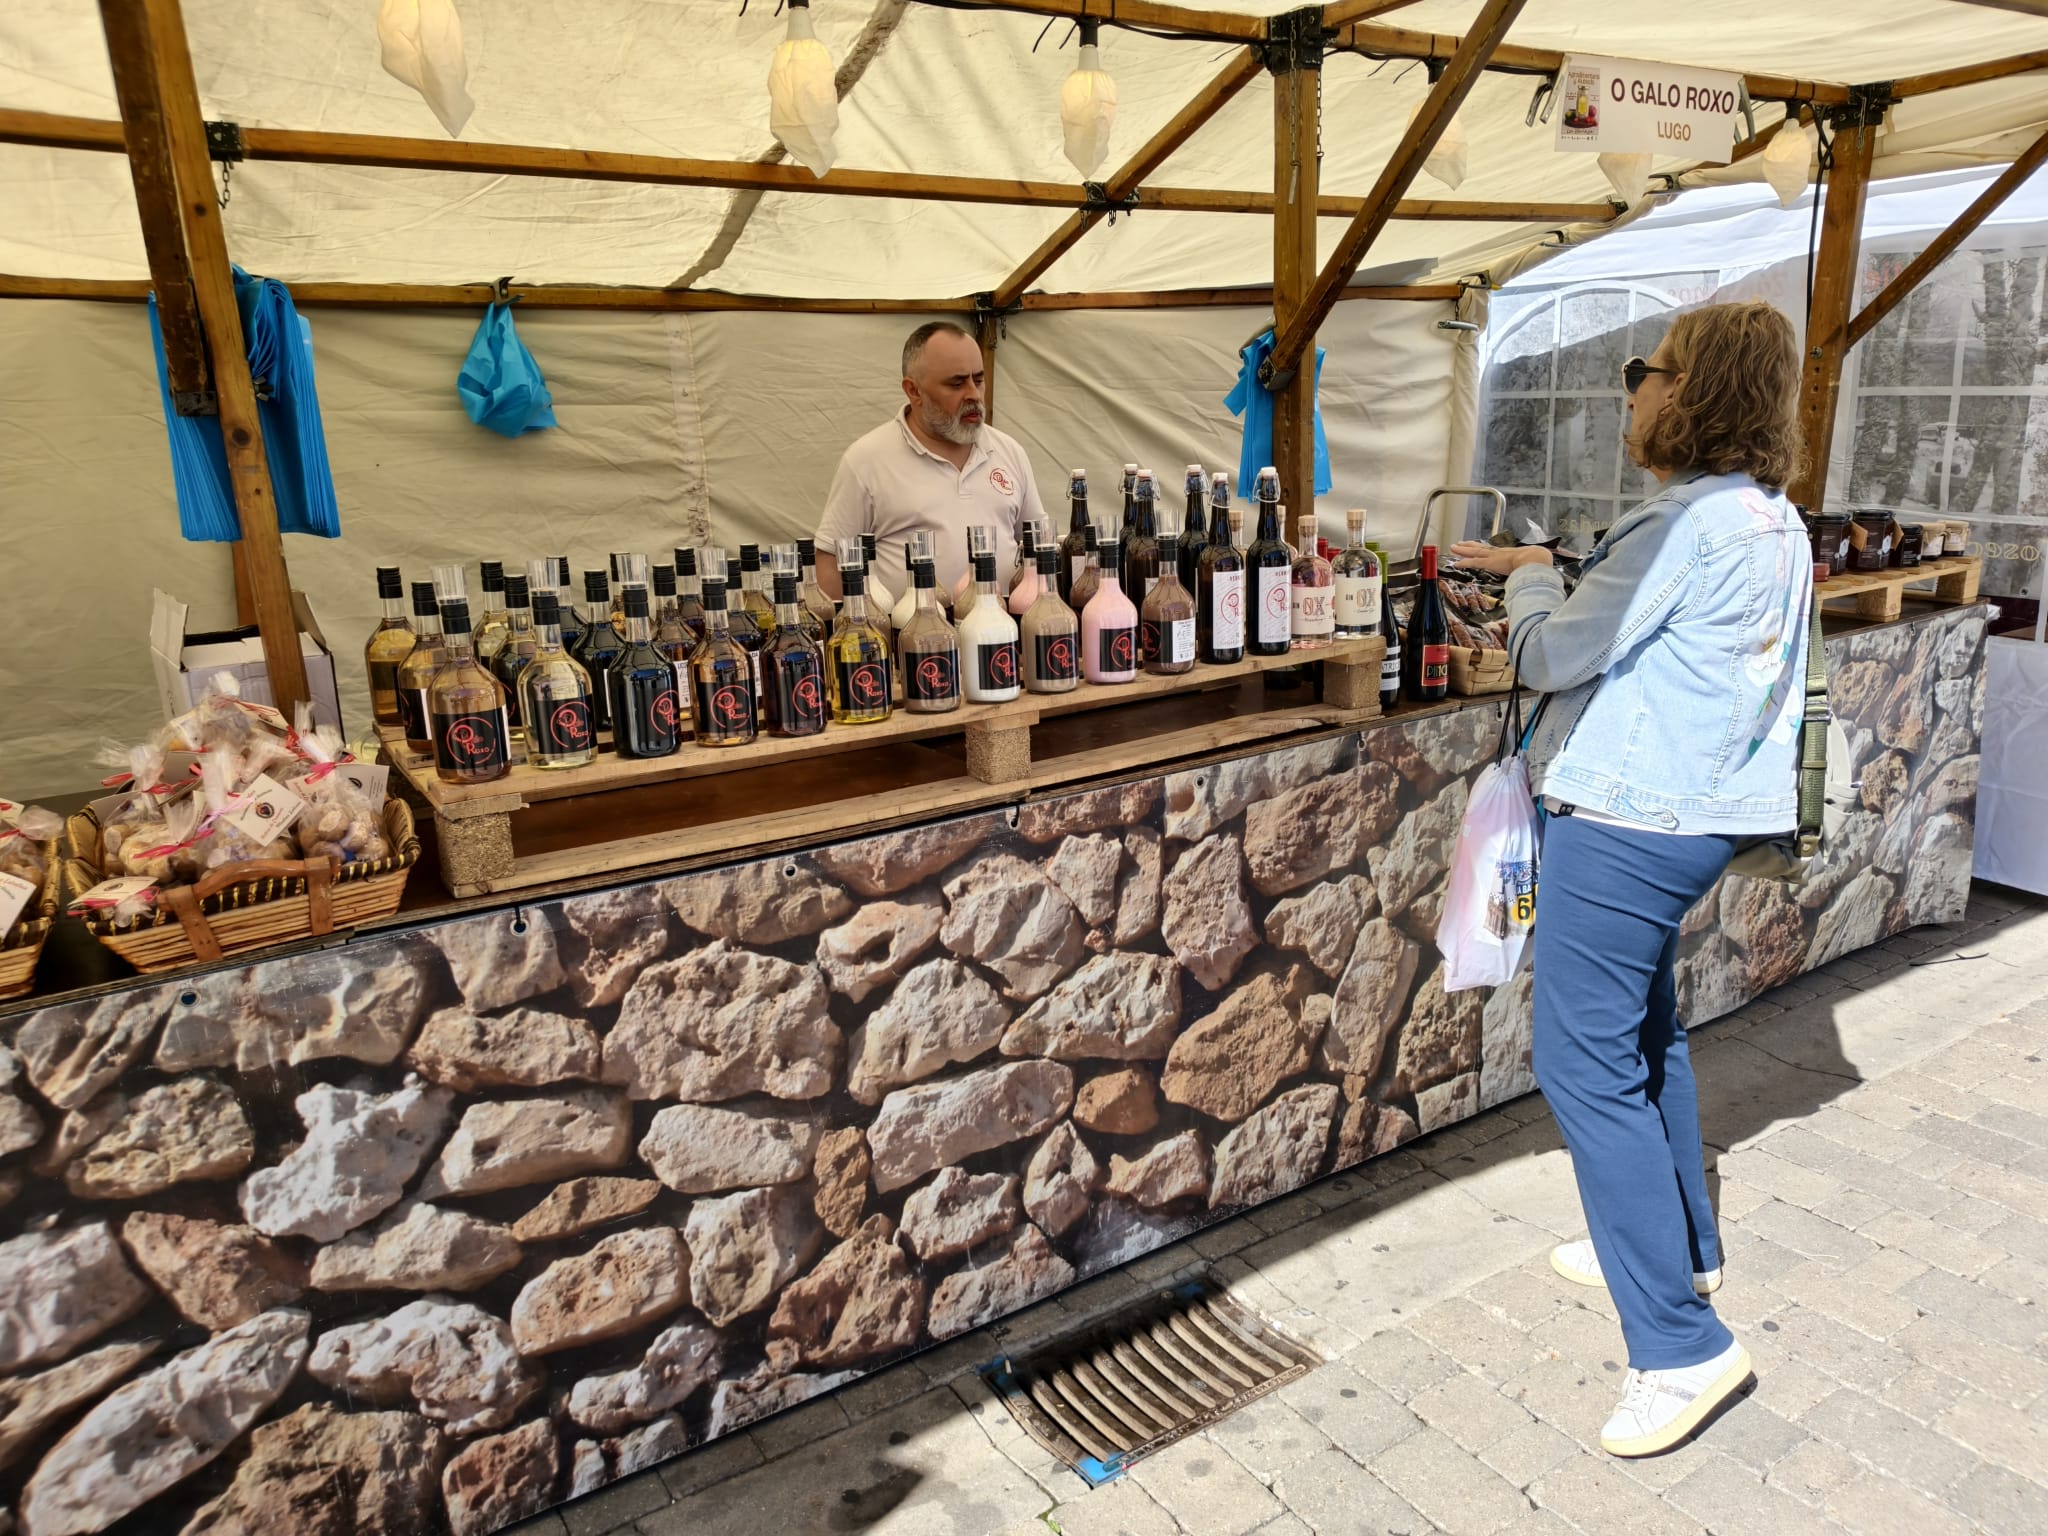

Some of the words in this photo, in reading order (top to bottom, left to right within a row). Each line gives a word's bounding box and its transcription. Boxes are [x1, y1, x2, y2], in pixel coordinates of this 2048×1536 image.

[1610, 78, 1626, 103] O
[1630, 80, 1681, 108] GALO
[1685, 86, 1736, 115] ROXO
[1656, 120, 1692, 142] LUGO
